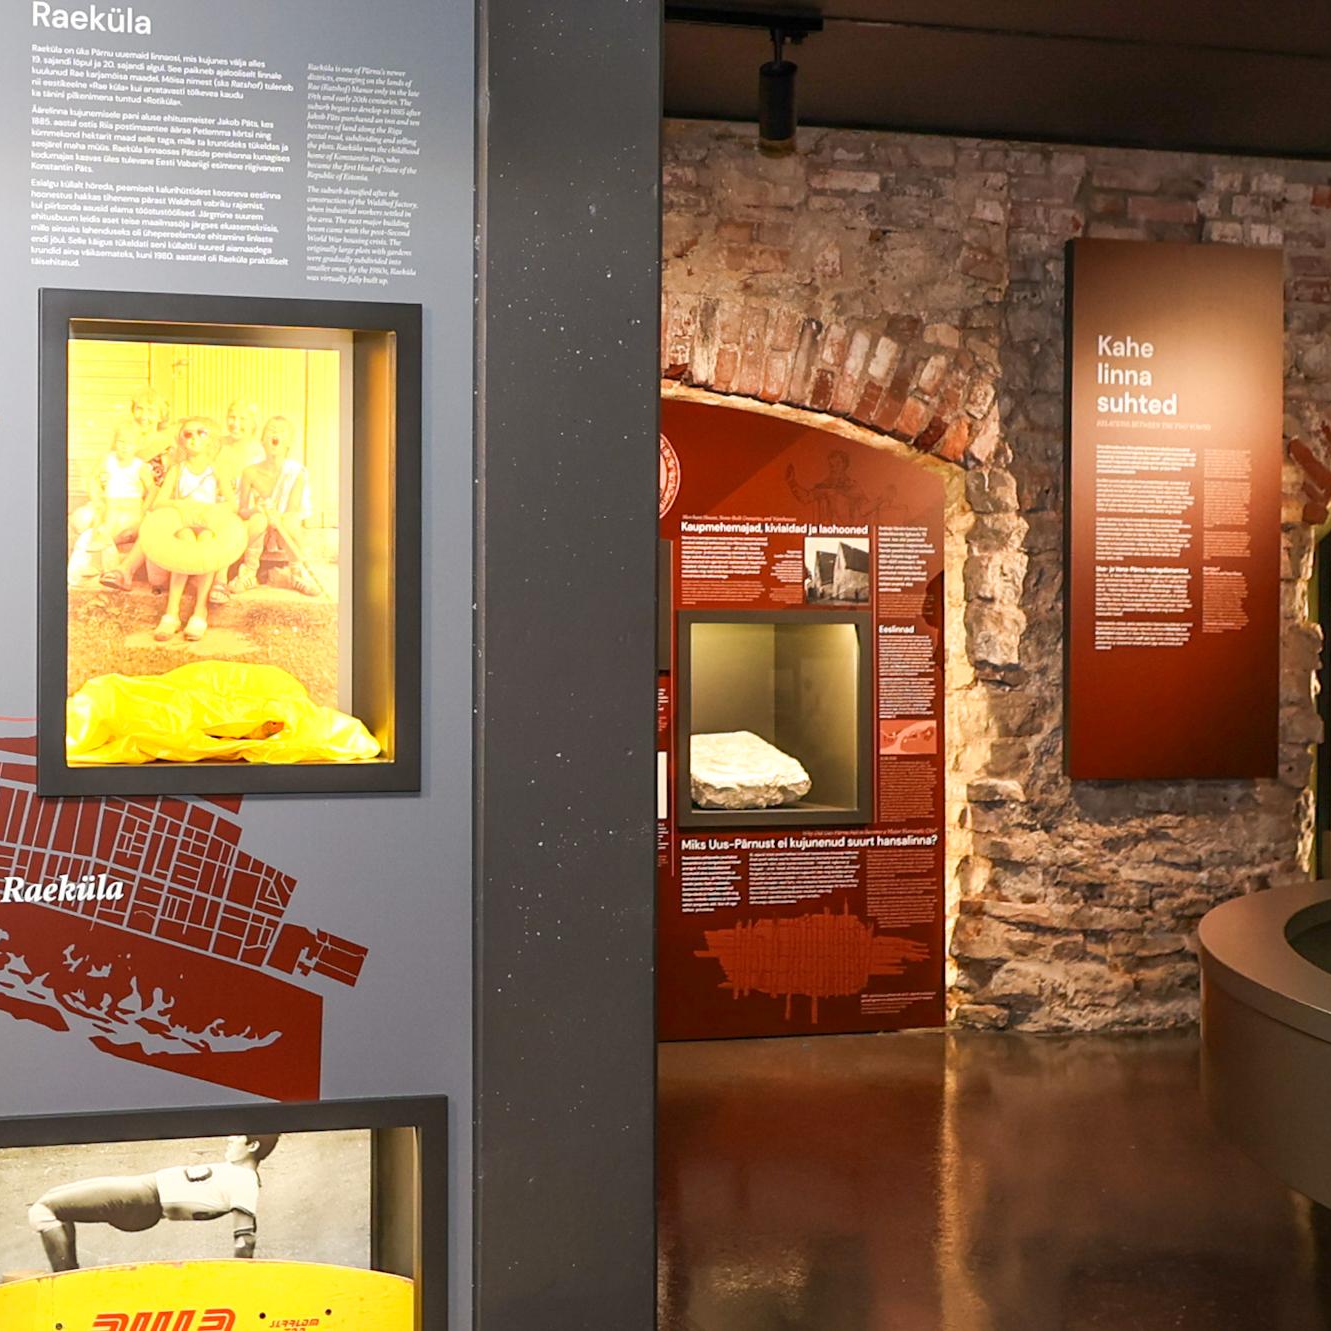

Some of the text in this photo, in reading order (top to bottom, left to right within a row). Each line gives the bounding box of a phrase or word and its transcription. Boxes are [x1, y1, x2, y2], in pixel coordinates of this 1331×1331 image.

[32, 1, 151, 35] Raeküla
[1098, 335, 1154, 358] Kahe
[1097, 362, 1153, 386] linna
[1097, 391, 1177, 415] suhted
[681, 834, 938, 851] Miks Uus-Pärnust ei kujunenud suurt hansalinna?
[0, 874, 125, 904] Raeküla
